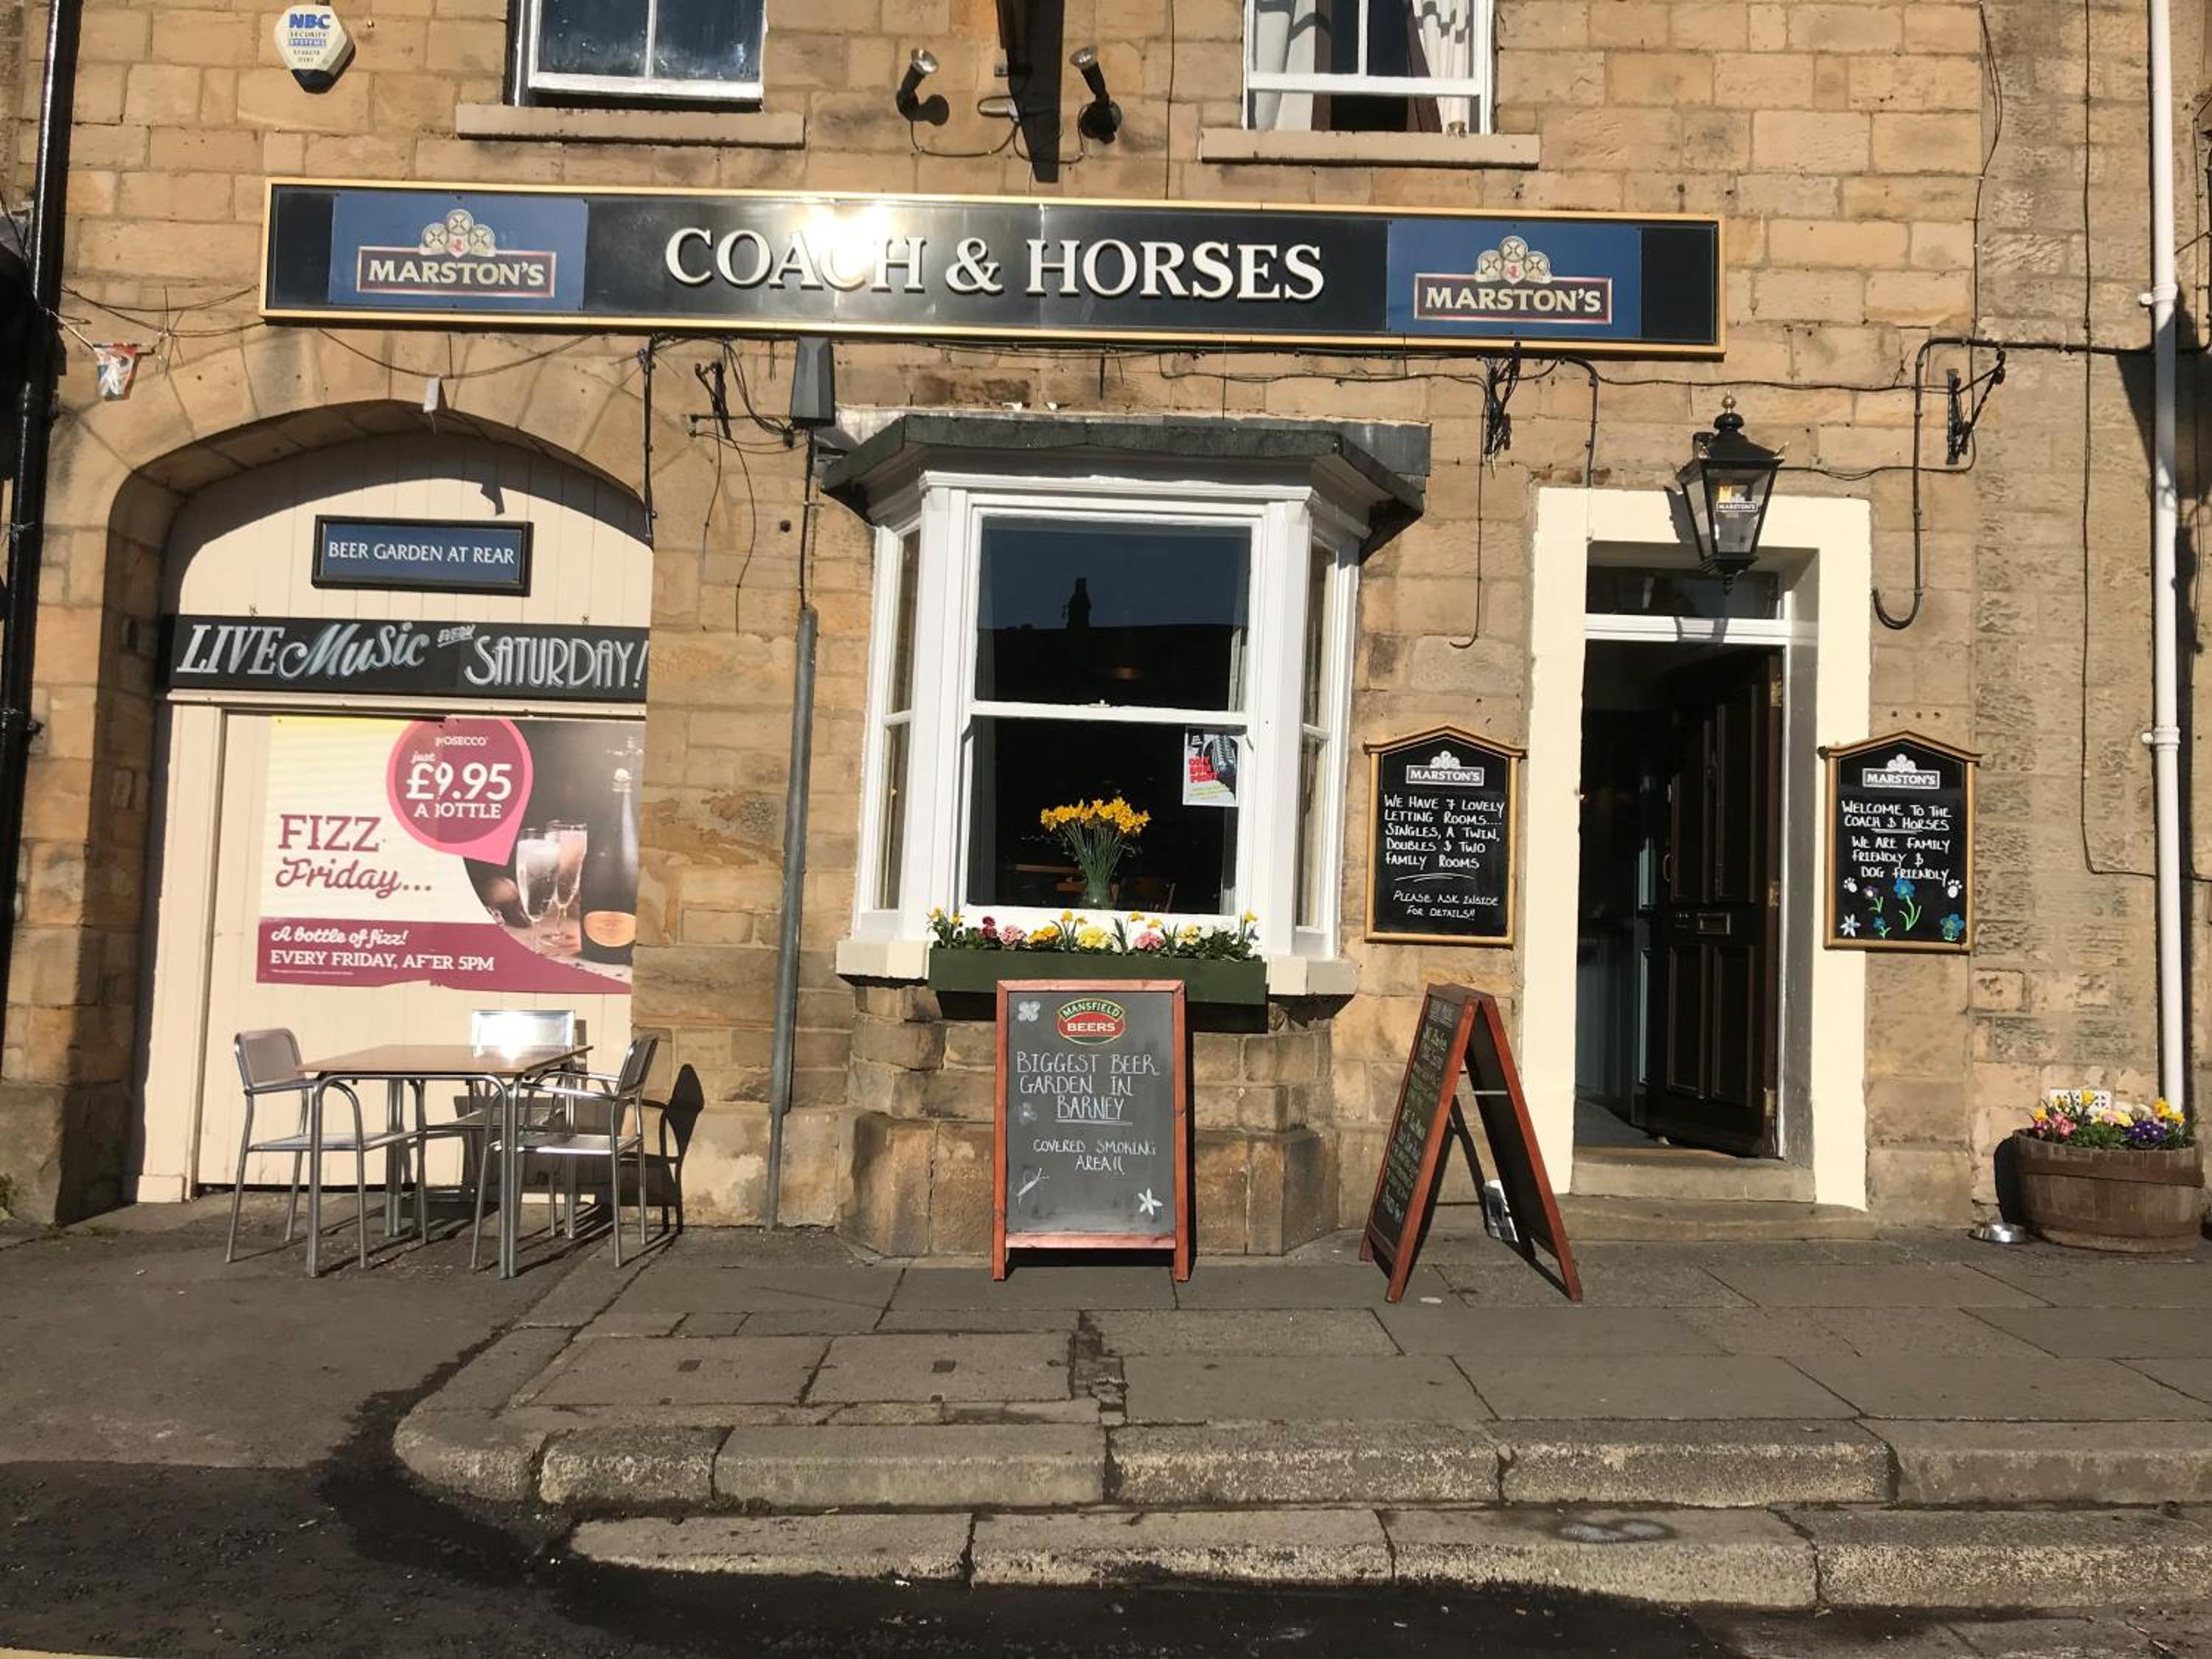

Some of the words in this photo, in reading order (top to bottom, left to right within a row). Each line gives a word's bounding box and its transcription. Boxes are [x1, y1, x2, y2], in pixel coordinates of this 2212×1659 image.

[289, 14, 330, 29] NBC
[368, 260, 545, 285] MARSTON'S
[665, 227, 928, 292] COACH
[945, 237, 1003, 293] &
[1026, 237, 1325, 302] HORSES
[1425, 287, 1601, 312] MARSTON'S
[328, 542, 369, 558] BEER
[374, 543, 443, 561] GARDEN
[446, 546, 469, 562] AT
[473, 547, 514, 564] REAR
[176, 625, 285, 675] LIVE
[464, 633, 649, 689] SATURDAY!
[435, 736, 487, 747] POSECCO
[411, 751, 436, 764] just
[406, 762, 512, 801] £9.95
[1410, 771, 1480, 781] MARSTON'S
[1866, 773, 1936, 785] MARSTON'S
[414, 803, 429, 818] A
[1384, 794, 1402, 807] WE
[1408, 796, 1439, 810] HAVE
[1446, 799, 1455, 810] 7
[1462, 799, 1505, 819] LOVELY
[1841, 800, 1904, 815] WELCOME
[1910, 804, 1925, 816] TO
[1929, 805, 1953, 818] THE
[1384, 810, 1433, 823] LETTING
[1844, 815, 1880, 828] COACH
[1902, 818, 1950, 831] HORSES
[278, 814, 381, 852] FIZZ
[1385, 823, 1441, 839] SINGLES,
[1446, 827, 1455, 838] A
[1463, 827, 1500, 842] TWIN,
[1386, 837, 1436, 852] DOUBLES
[1458, 841, 1486, 853] TWO
[1851, 835, 1870, 848] WE
[1875, 837, 1897, 848] ARE
[1906, 837, 1950, 854] FAMILY
[1385, 851, 1427, 870] FAMILY
[1439, 855, 1480, 869] ROOMS
[1851, 849, 1907, 869] FRIENDLY
[276, 857, 432, 899] Friday...
[1861, 866, 1885, 878] DOG
[1892, 866, 1950, 887] FRIENDLY
[1393, 890, 1432, 903] PLEASE
[1437, 893, 1459, 903] ASK
[1462, 895, 1499, 906] INSIDE
[1407, 905, 1424, 916] FOR
[271, 925, 292, 942] A
[294, 925, 347, 943] bottle
[349, 928, 368, 948] of
[365, 928, 408, 948] fizz!
[271, 949, 327, 965] EVERY
[332, 951, 398, 969] FRIDAY,
[458, 956, 495, 971] 5PM
[1062, 1002, 1120, 1017] MANSFIELD
[1067, 1023, 1116, 1032] BEERS
[1017, 1051, 1103, 1073] BIGGEST
[1110, 1054, 1161, 1076] BEER
[1020, 1074, 1093, 1094] GARDEN
[1110, 1075, 1133, 1096] IN
[1057, 1095, 1124, 1120] BARNEY
[1033, 1139, 1085, 1153] COVERED
[1096, 1140, 1157, 1155] SMOKING
